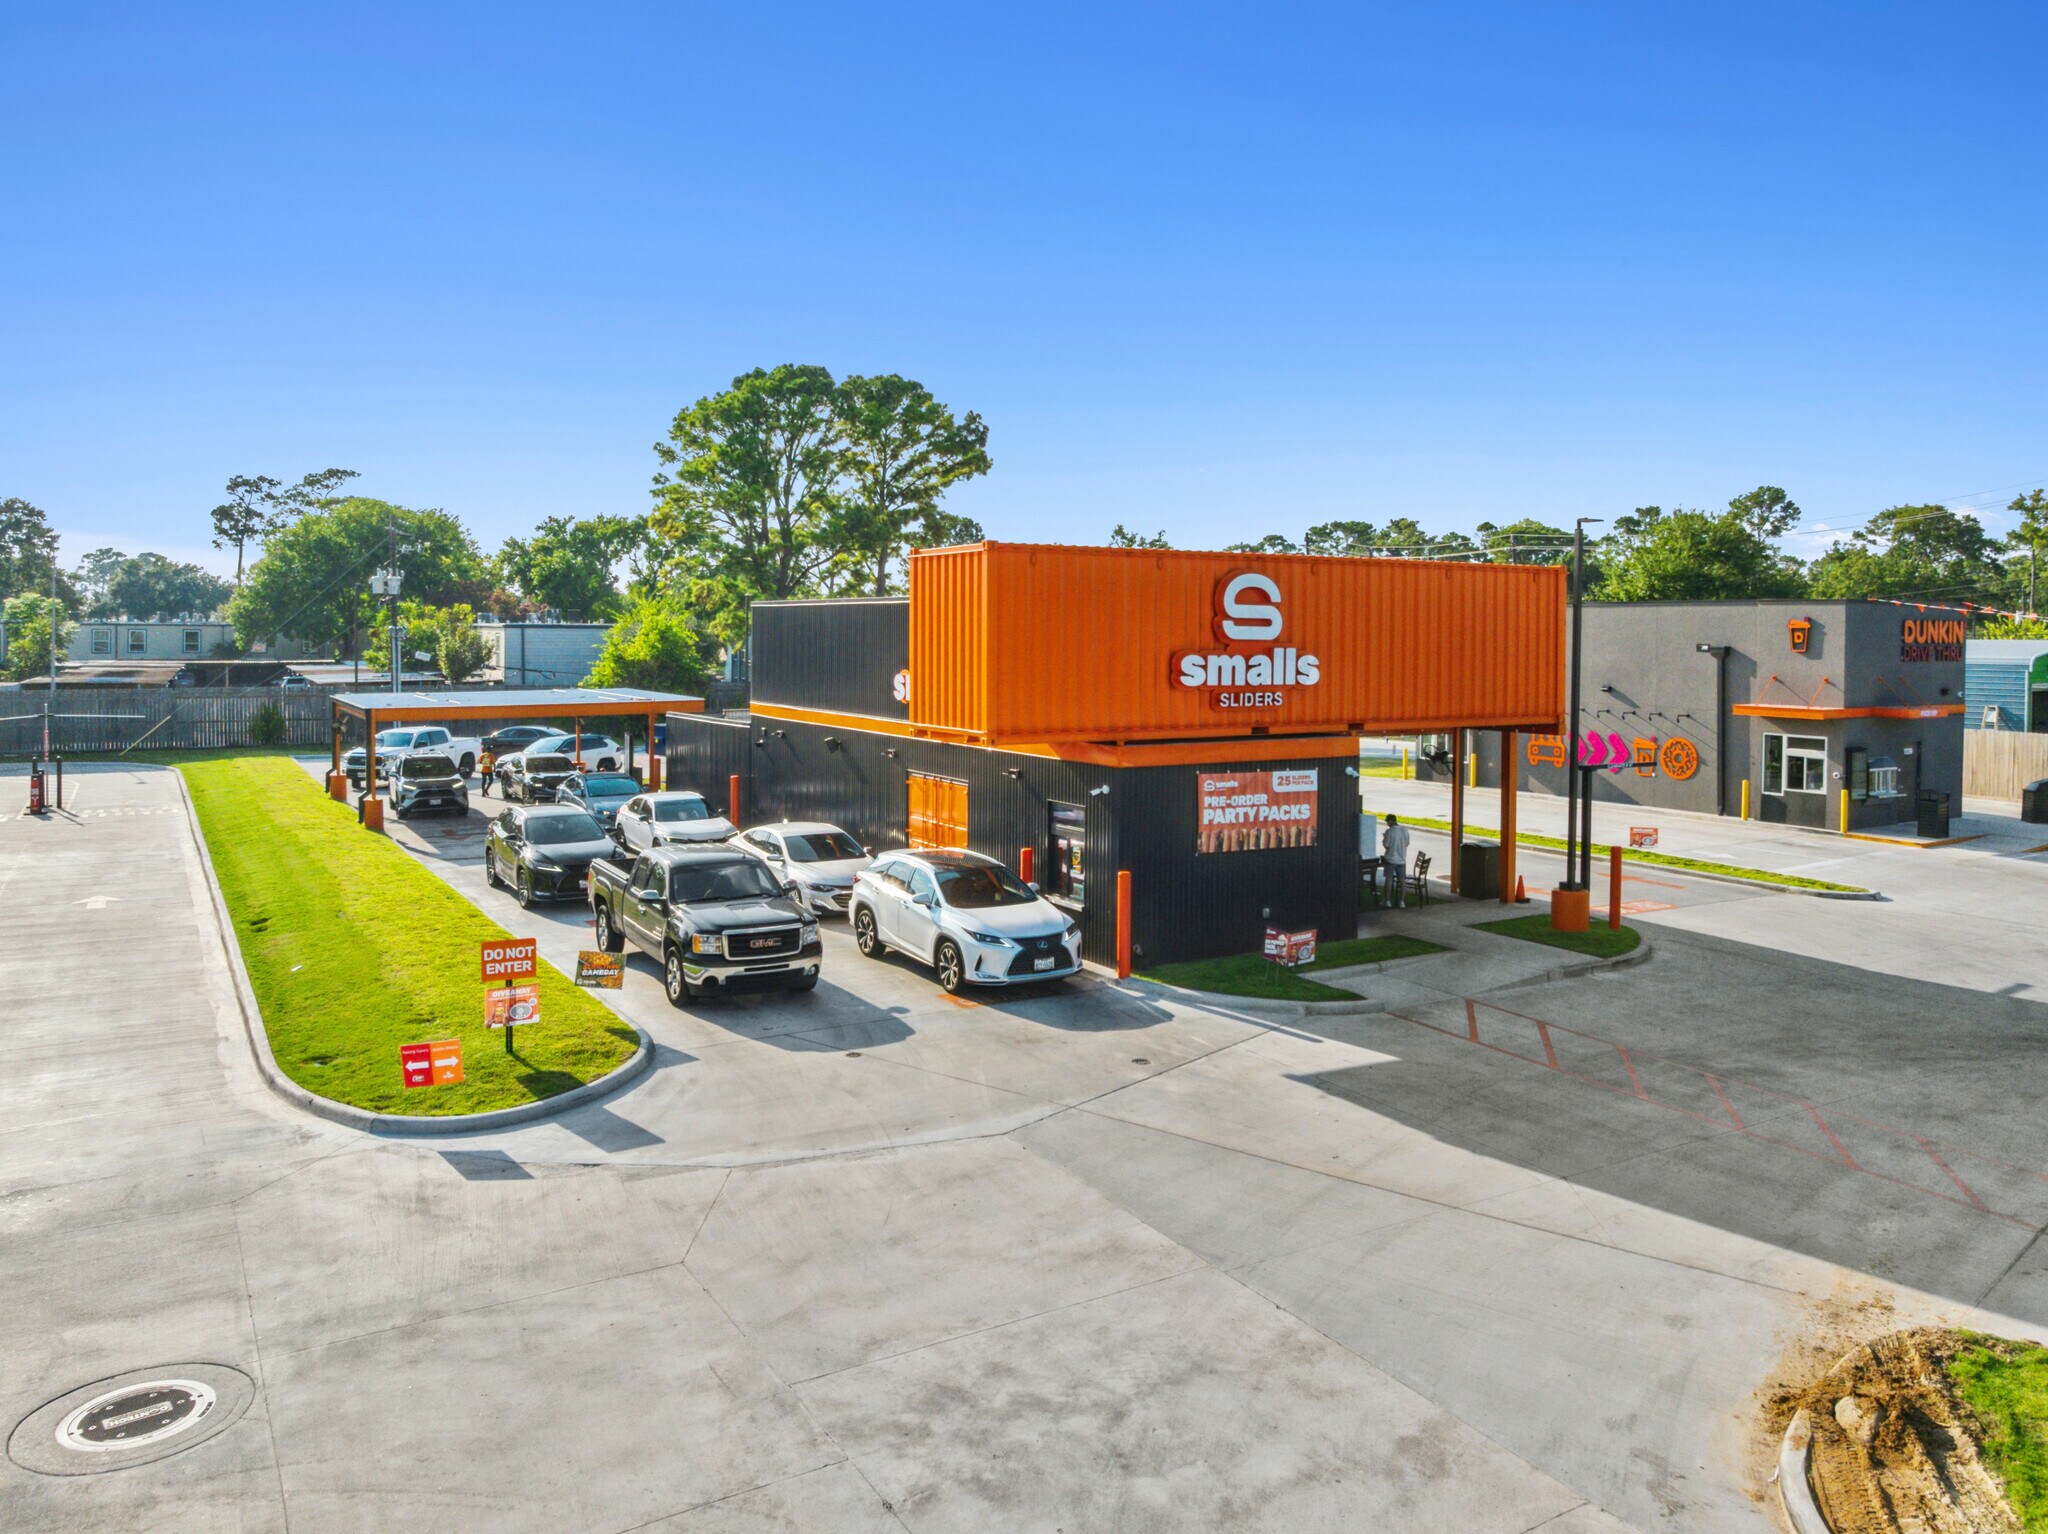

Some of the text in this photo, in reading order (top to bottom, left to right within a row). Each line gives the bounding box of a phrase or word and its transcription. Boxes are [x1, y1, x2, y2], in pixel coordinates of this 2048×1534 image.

[1222, 572, 1283, 641] S
[1903, 646, 1963, 661] DRIVE THRU
[1179, 647, 1321, 687] smalls
[1219, 692, 1283, 708] SLIDERS
[1277, 776, 1291, 787] 25
[1204, 793, 1268, 807] PRE-ORDER
[1203, 804, 1311, 825] PARTY PACKS
[750, 937, 782, 949] GMC
[483, 945, 535, 962] DO NOT
[486, 960, 532, 975] ENTER
[492, 986, 531, 998] GIVEAWAY
